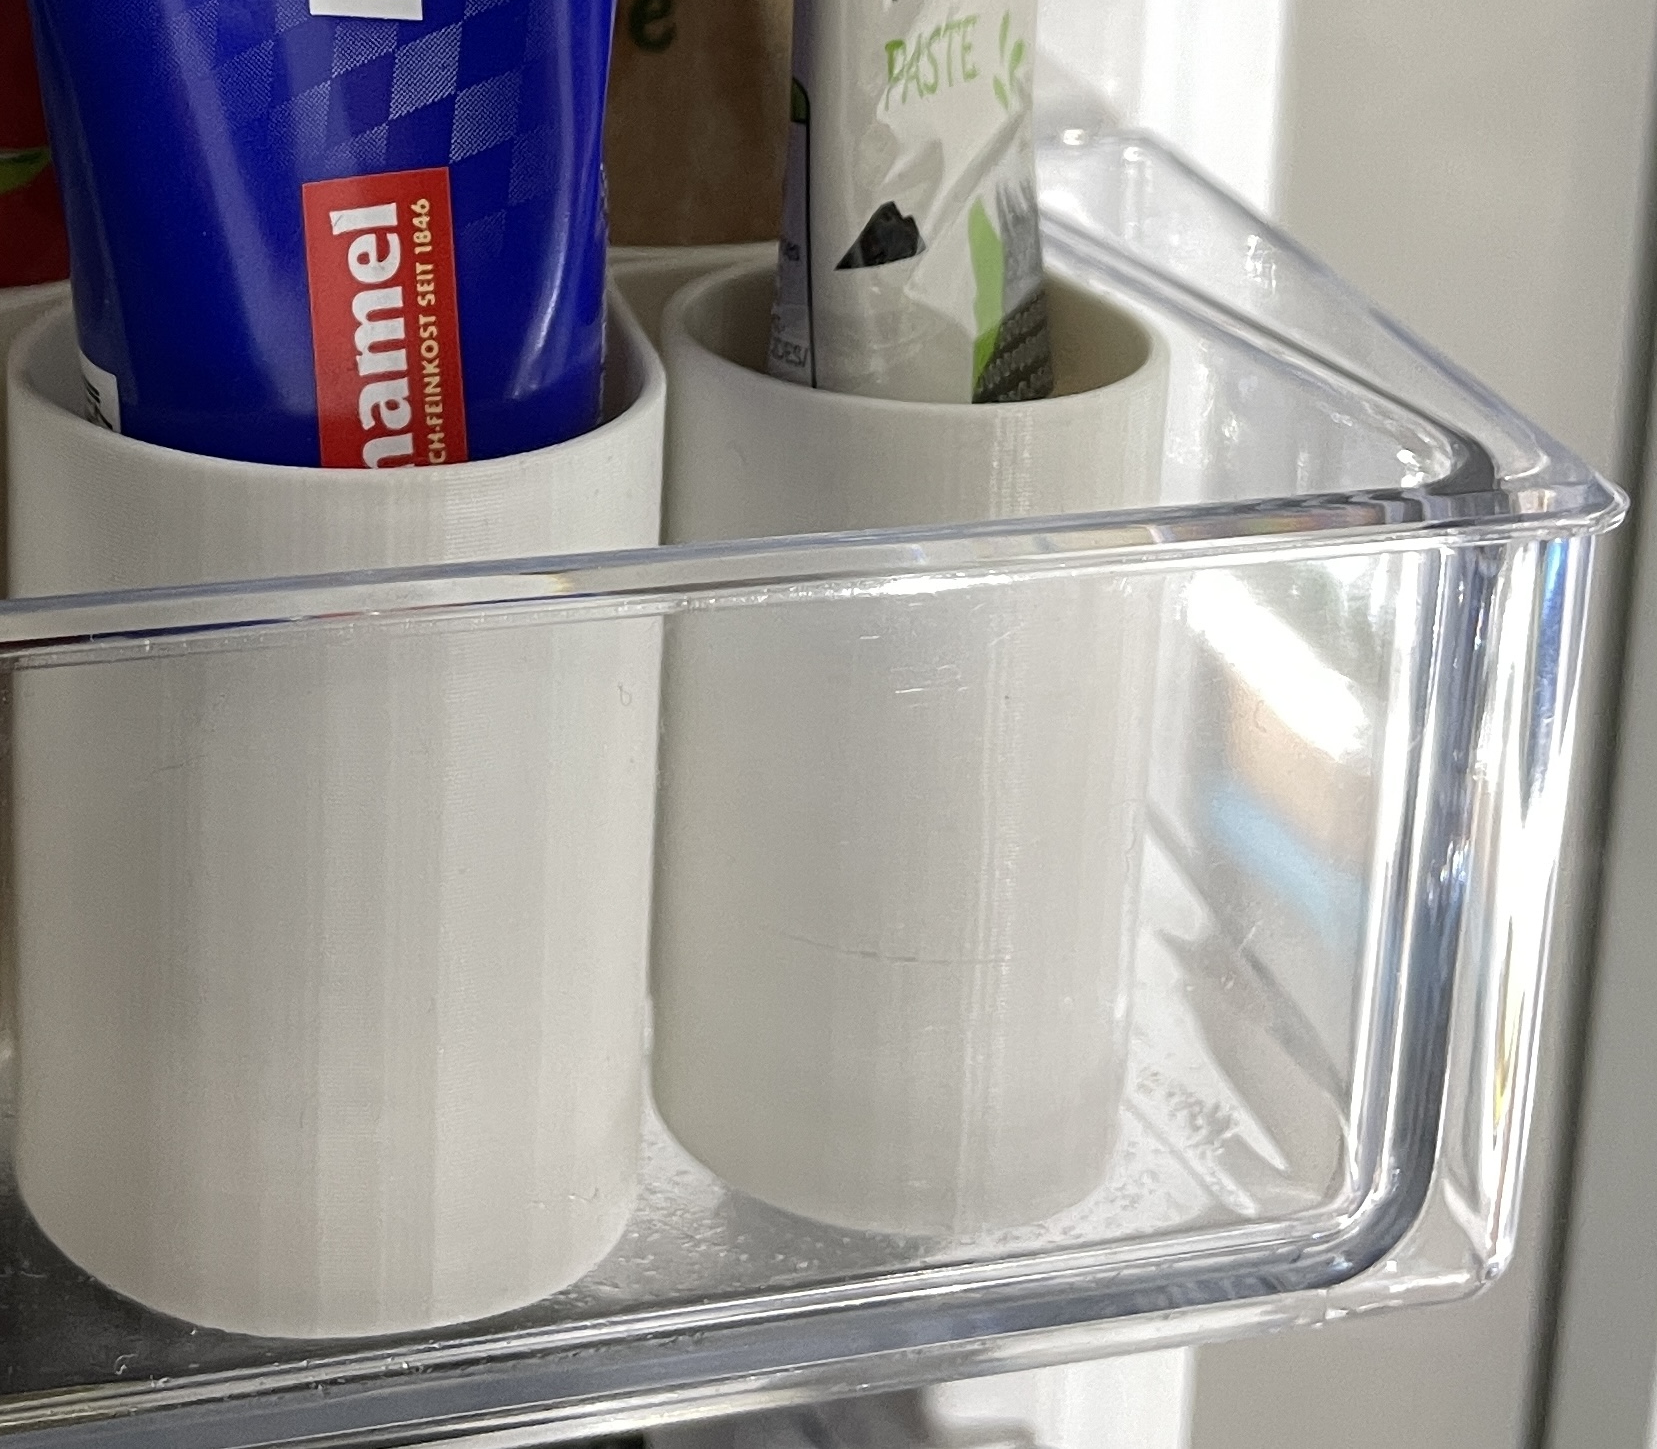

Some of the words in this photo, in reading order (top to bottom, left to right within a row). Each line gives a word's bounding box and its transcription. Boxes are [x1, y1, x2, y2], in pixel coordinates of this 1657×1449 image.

[884, 14, 979, 112] PASTE
[410, 198, 433, 255] 1846
[414, 261, 436, 308] SEIT
